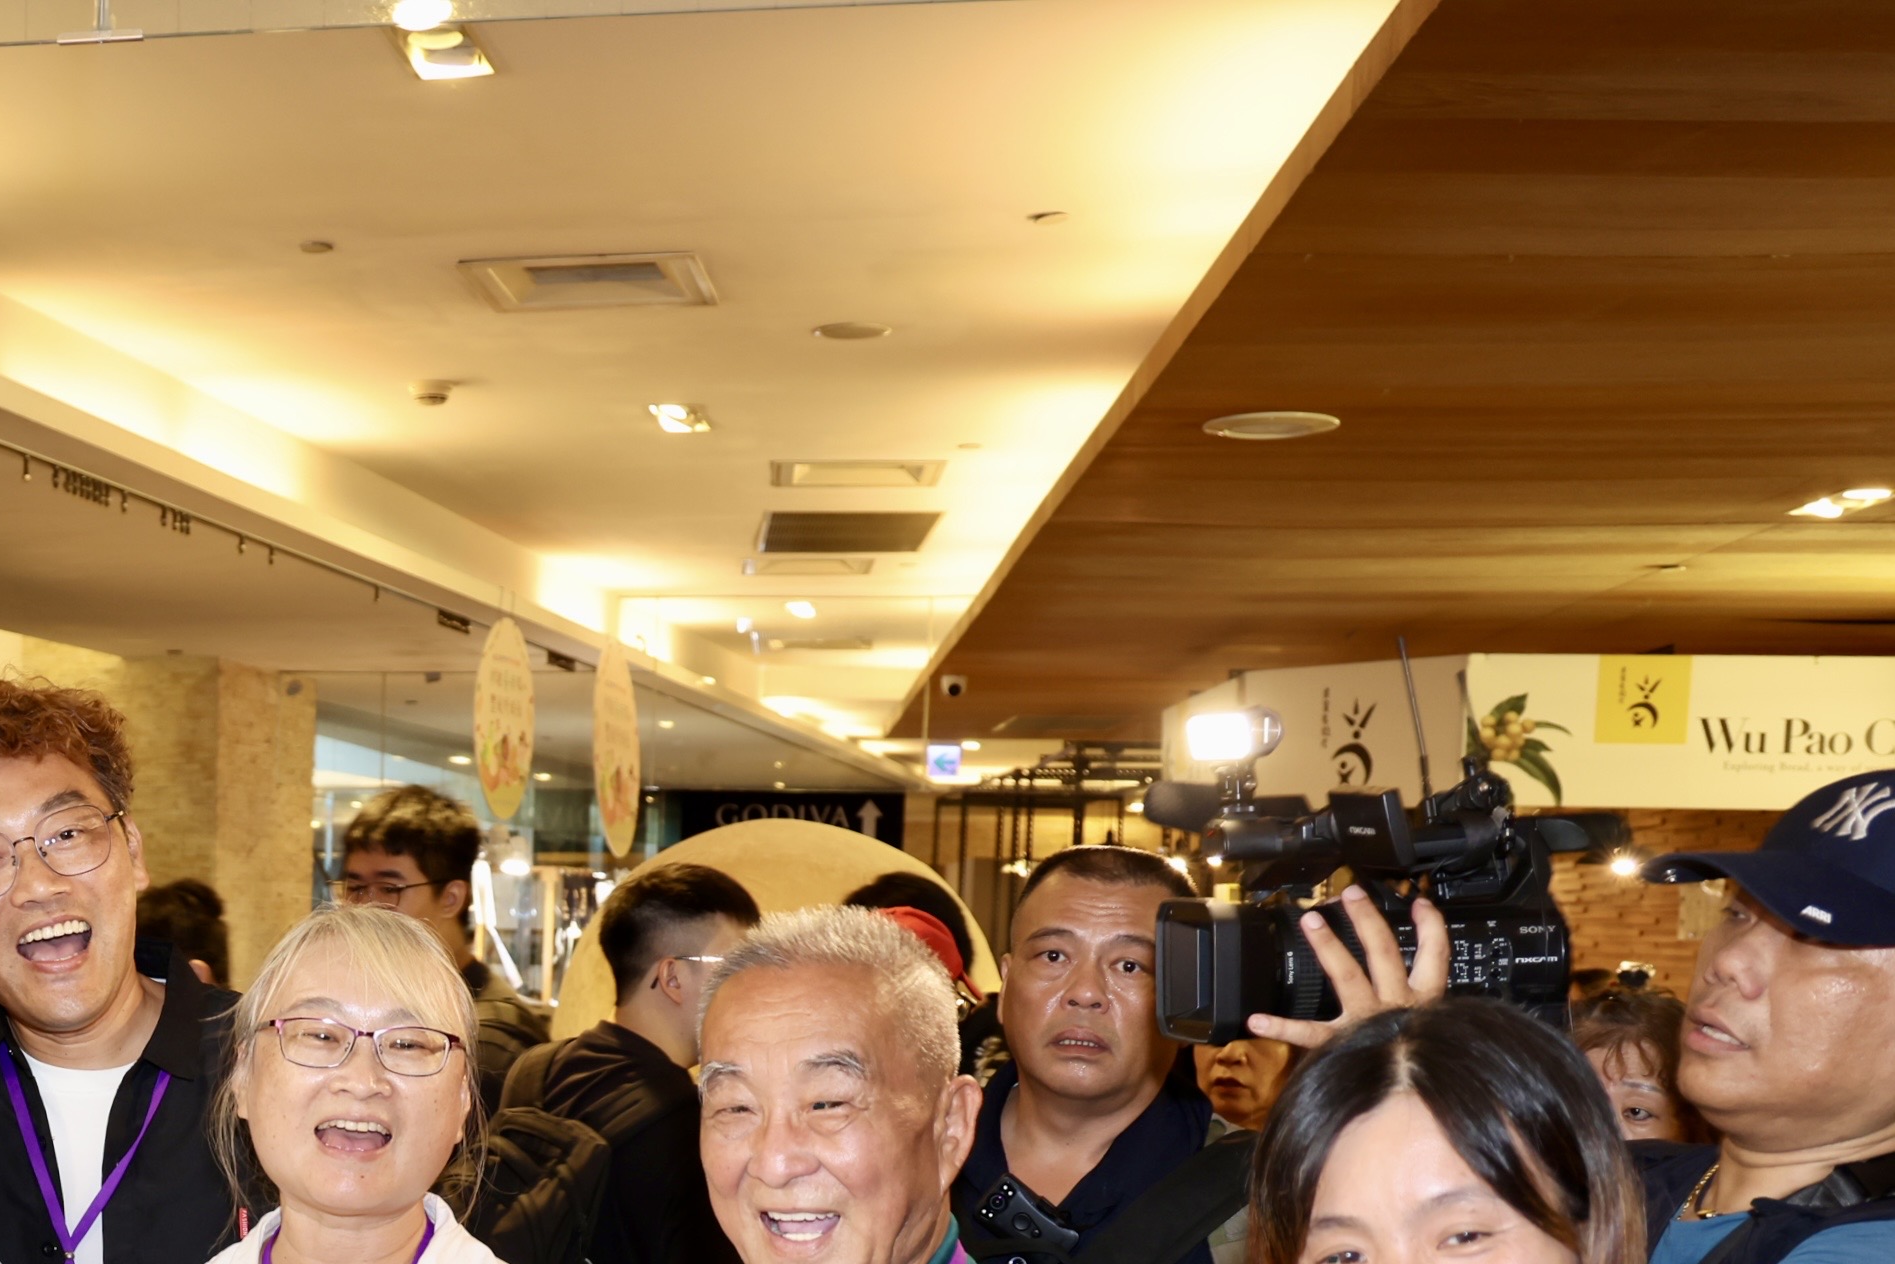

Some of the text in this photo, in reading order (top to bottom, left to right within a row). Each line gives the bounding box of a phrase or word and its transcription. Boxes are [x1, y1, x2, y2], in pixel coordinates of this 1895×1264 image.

[1698, 717, 1770, 755] Wu
[1782, 717, 1853, 755] Pao
[1801, 904, 1833, 925] ARRI
[1520, 925, 1556, 934] SONY
